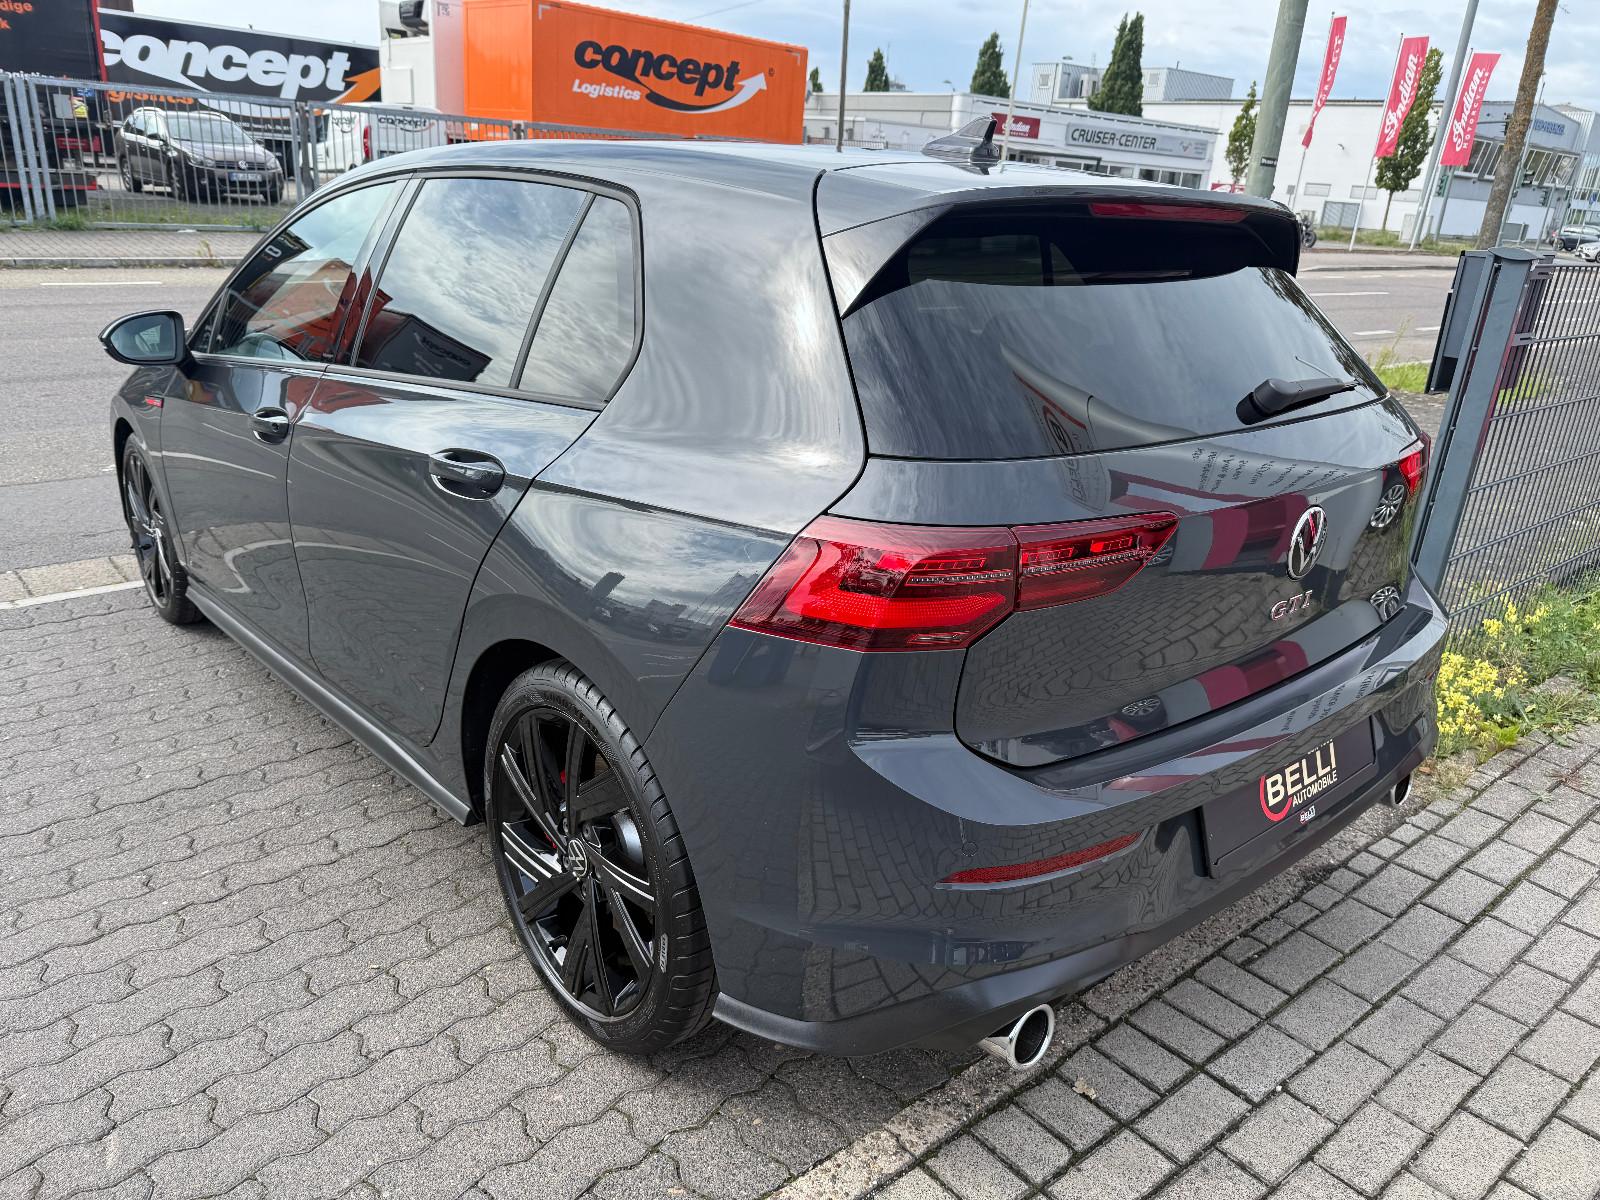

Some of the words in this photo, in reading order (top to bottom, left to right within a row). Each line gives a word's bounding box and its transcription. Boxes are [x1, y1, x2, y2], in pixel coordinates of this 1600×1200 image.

[101, 28, 351, 98] concept
[574, 40, 740, 96] concept
[572, 79, 641, 101] Logistics
[1453, 68, 1485, 152] Indian
[1071, 128, 1157, 150] CRUISER-CENTER
[1271, 590, 1313, 620] GTI
[1266, 742, 1337, 807] BELLI
[1293, 770, 1338, 807] AUTOMOBILE
